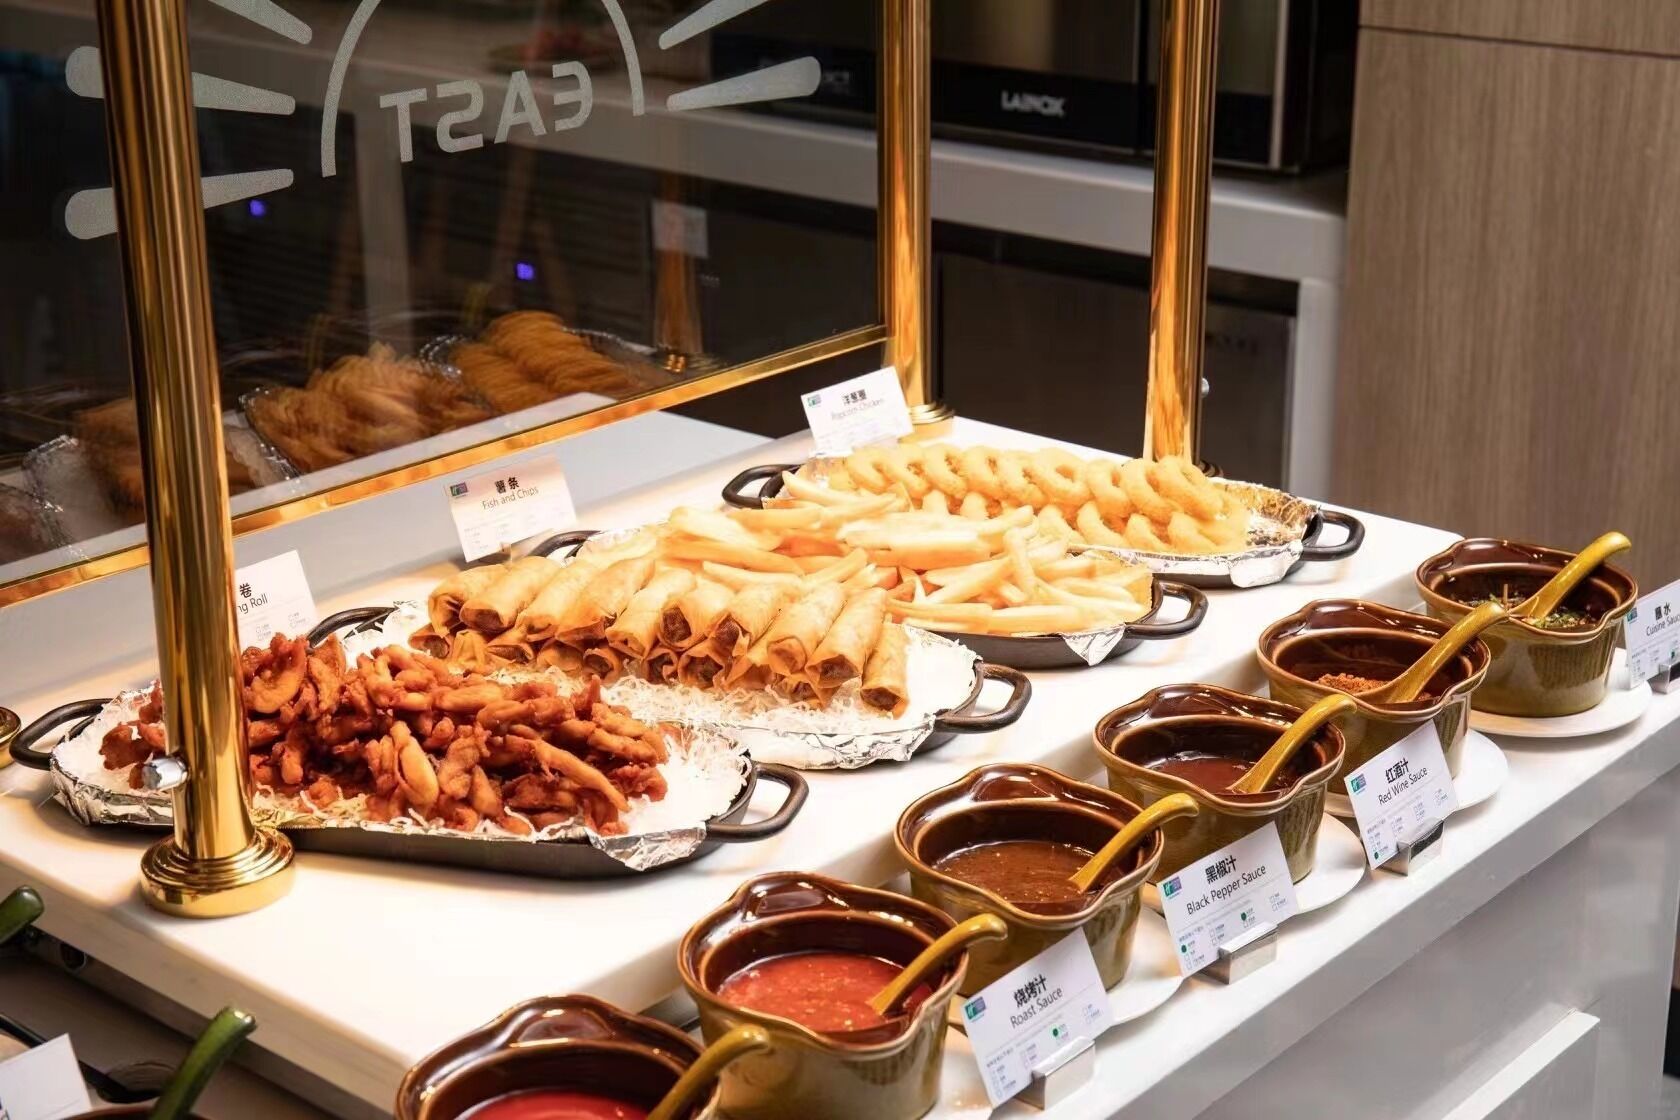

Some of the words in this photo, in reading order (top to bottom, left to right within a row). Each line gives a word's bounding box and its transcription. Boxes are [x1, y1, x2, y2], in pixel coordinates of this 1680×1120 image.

[482, 498, 499, 510] Fish
[501, 493, 516, 505] and
[518, 486, 539, 499] Chips
[495, 476, 520, 494] 薯条
[239, 582, 252, 598] 卷
[249, 593, 268, 608] Roll
[1385, 757, 1409, 783] 红酒汁
[1378, 790, 1392, 806] Red
[1392, 779, 1409, 797] Wine
[1410, 766, 1428, 785] Sauce
[1204, 855, 1237, 884] 黑椒汁
[1187, 895, 1210, 915] Black
[1211, 879, 1241, 902] Pepper
[1241, 864, 1267, 885] Sauce
[1014, 974, 1047, 1008] 烧烤汁
[1010, 1005, 1037, 1029] Roast
[1036, 987, 1063, 1011] Sauce
